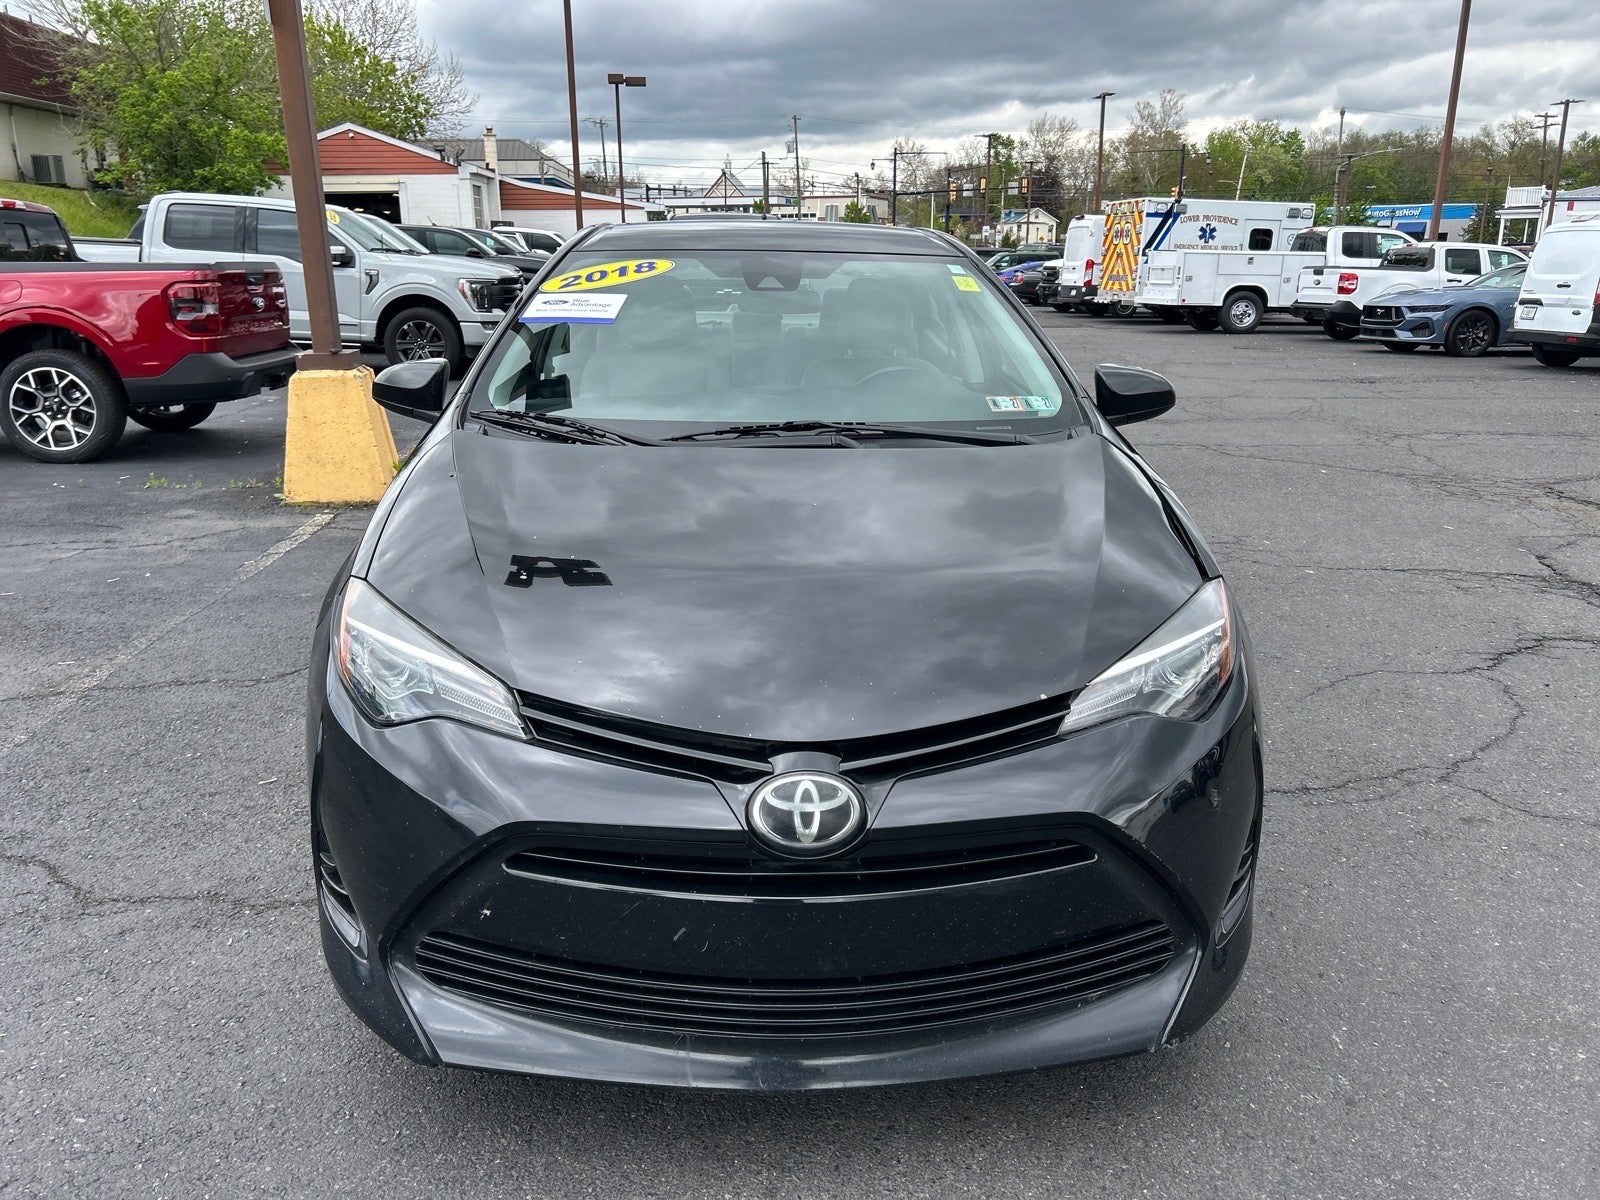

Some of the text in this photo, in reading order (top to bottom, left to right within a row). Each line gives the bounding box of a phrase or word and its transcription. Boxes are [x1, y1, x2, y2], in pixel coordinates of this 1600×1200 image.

[1366, 208, 1422, 219] AutoGssNow!
[1180, 215, 1239, 225] LOWER PROVIDENCE
[558, 261, 658, 289] 2018
